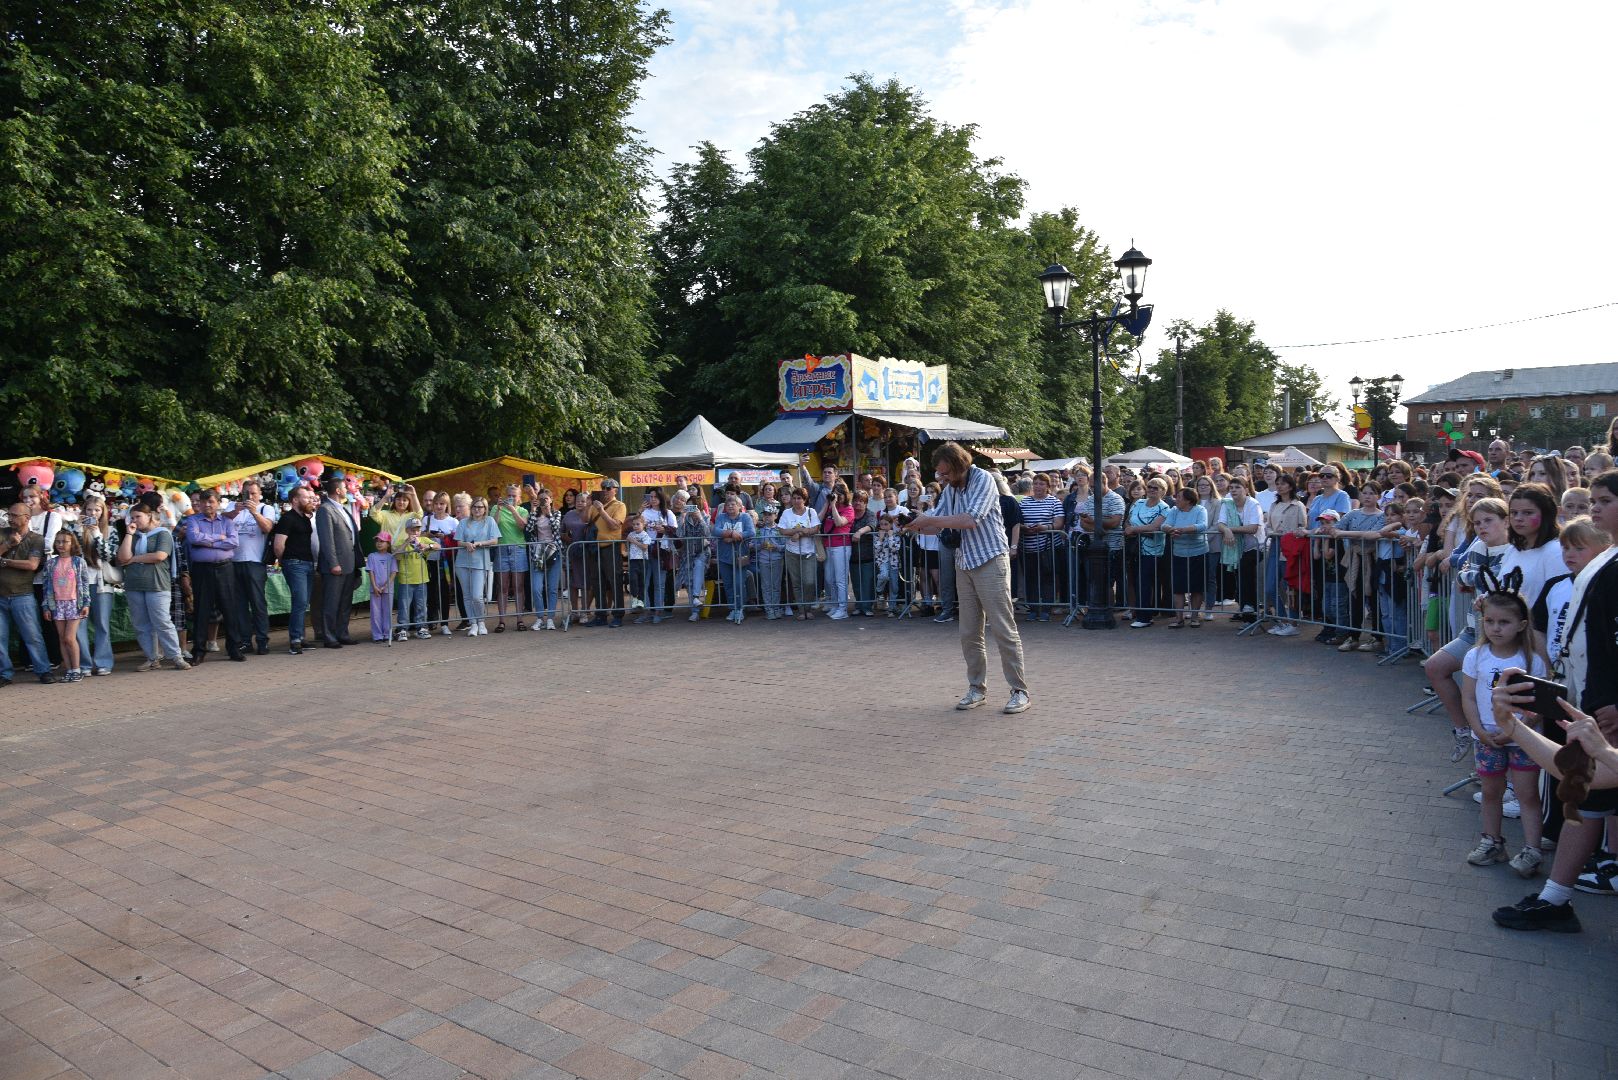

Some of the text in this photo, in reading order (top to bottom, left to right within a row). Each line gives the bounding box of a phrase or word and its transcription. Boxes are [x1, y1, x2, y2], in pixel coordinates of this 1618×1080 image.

[631, 473, 705, 484] БЫСТРО И СНО!
